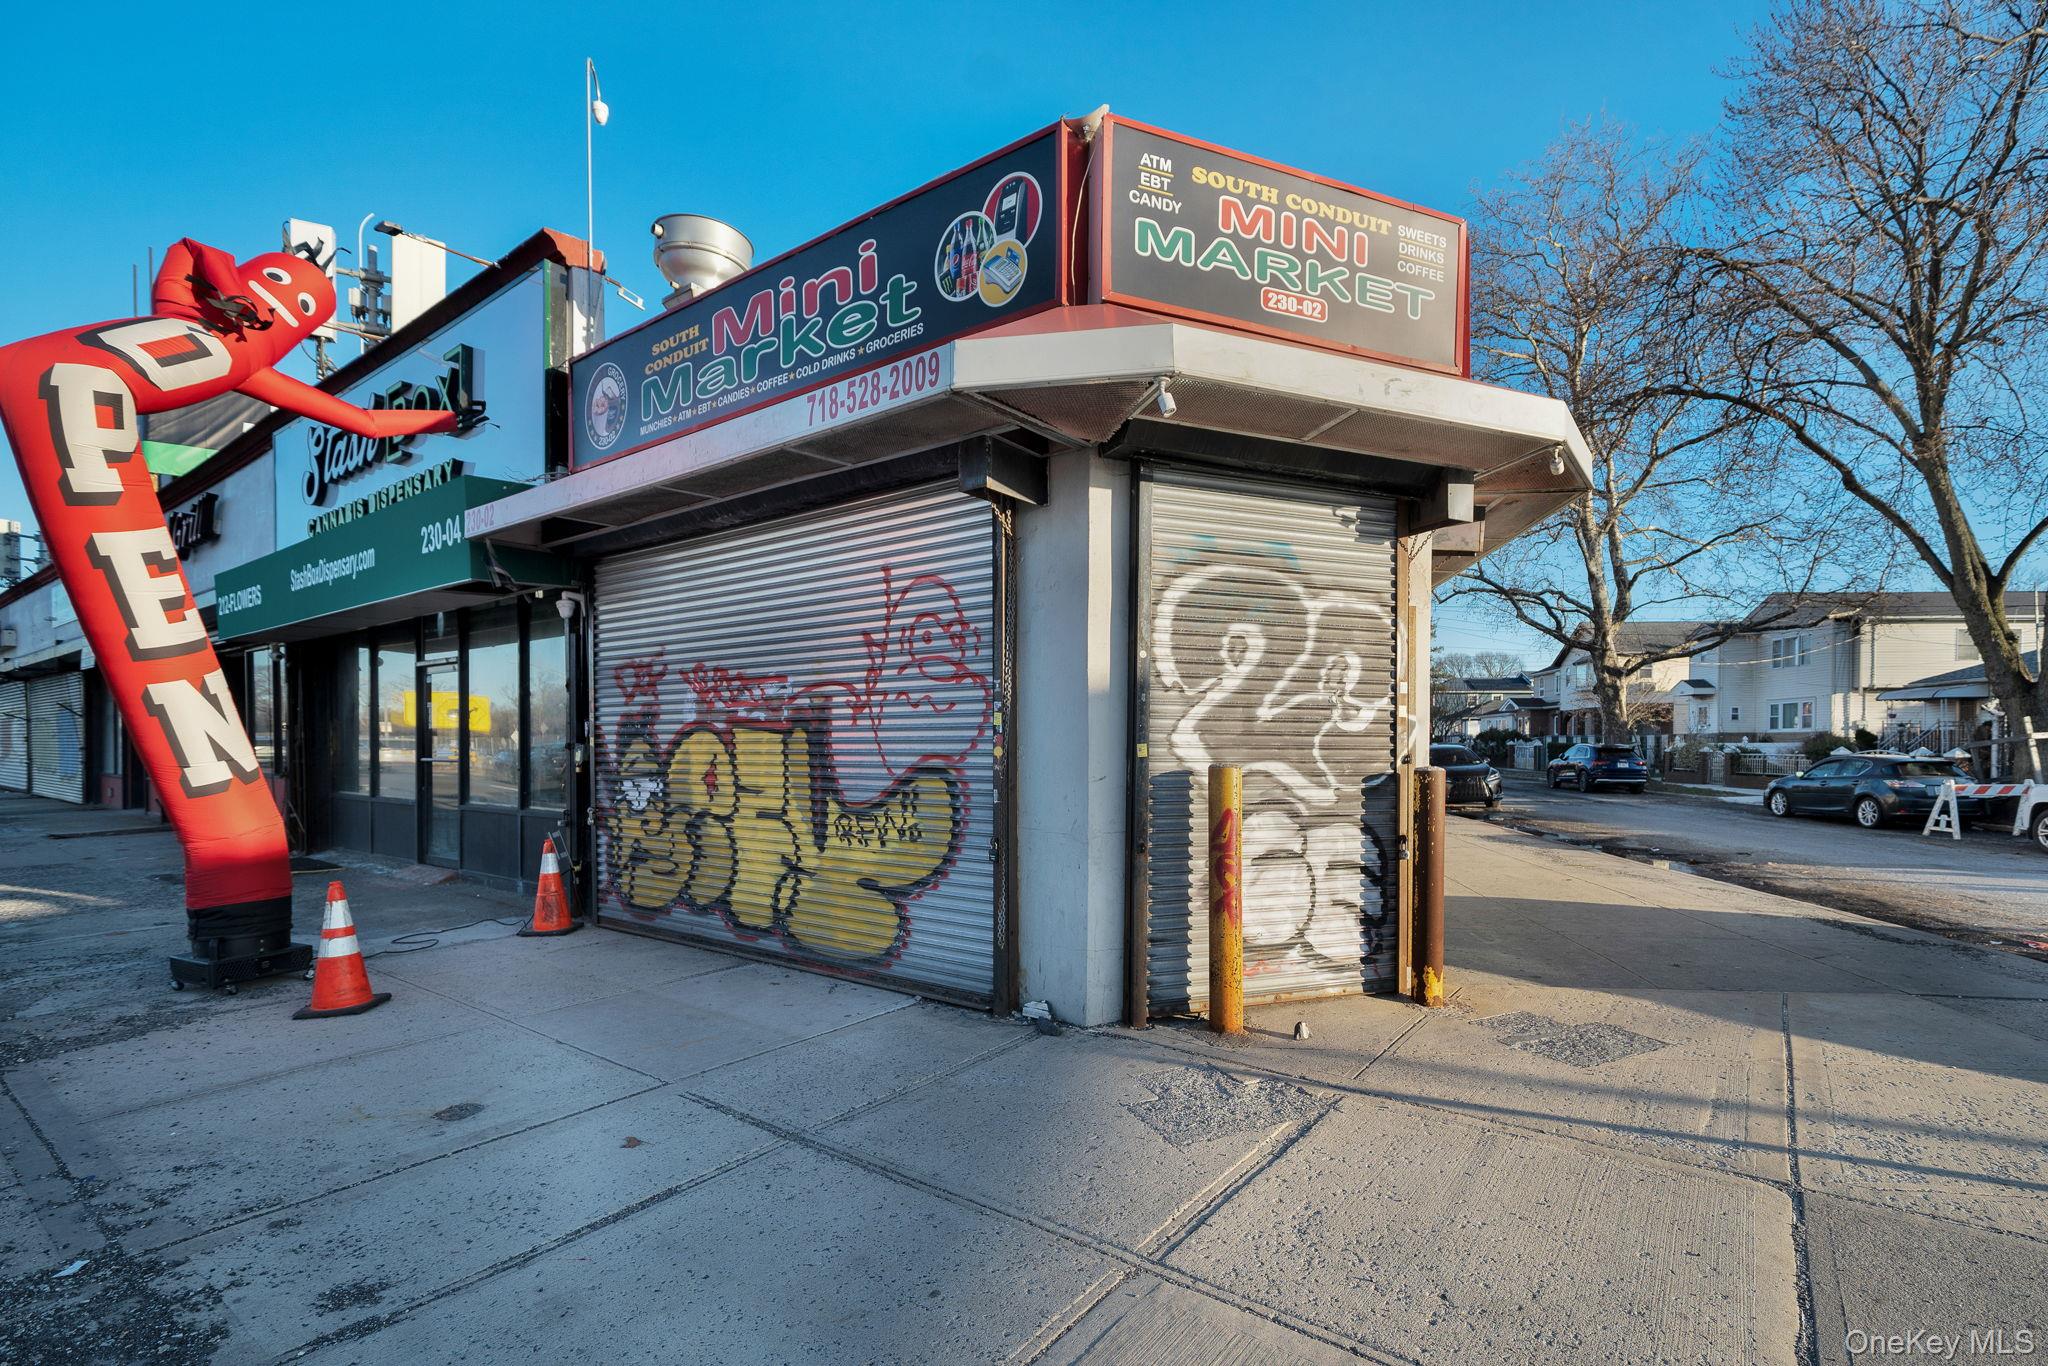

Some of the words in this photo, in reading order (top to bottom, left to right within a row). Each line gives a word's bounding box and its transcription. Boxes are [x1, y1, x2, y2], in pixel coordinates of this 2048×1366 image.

[1140, 152, 1172, 173] ATM
[1140, 172, 1171, 192] EBT
[1192, 166, 1279, 205] SOUTH
[1286, 193, 1392, 236] CONDUIT
[1129, 189, 1182, 214] CANDY
[1219, 195, 1368, 267] MINI
[1398, 224, 1447, 248] SWEETS
[1135, 217, 1435, 320] MARKET
[1397, 260, 1445, 282] COFFEE
[1399, 242, 1445, 264] DRINKS
[712, 238, 877, 356] Mini
[1267, 291, 1323, 318] 230-02
[641, 274, 922, 422] Market
[645, 337, 709, 375] CONDUIT
[652, 324, 700, 356] SOUTH
[639, 415, 673, 436] MUNCHIES
[677, 408, 692, 422] ATM
[697, 401, 712, 415] EBT
[717, 386, 750, 407] CANDIES
[756, 372, 789, 393] COFFEE
[796, 360, 821, 379] COLD
[821, 348, 856, 370] DRINKS
[865, 322, 924, 353] GROCERIES
[806, 351, 940, 427] 718-528-2009
[307, 499, 364, 537] CANNABIS
[367, 458, 454, 514] DISPENSARY
[420, 515, 462, 554] 230-04
[465, 504, 495, 533] 230-02
[40, 316, 259, 795] OPEN
[290, 547, 375, 592] StashBoxDispensary.com
[217, 584, 262, 615] 212-FLOWERS
